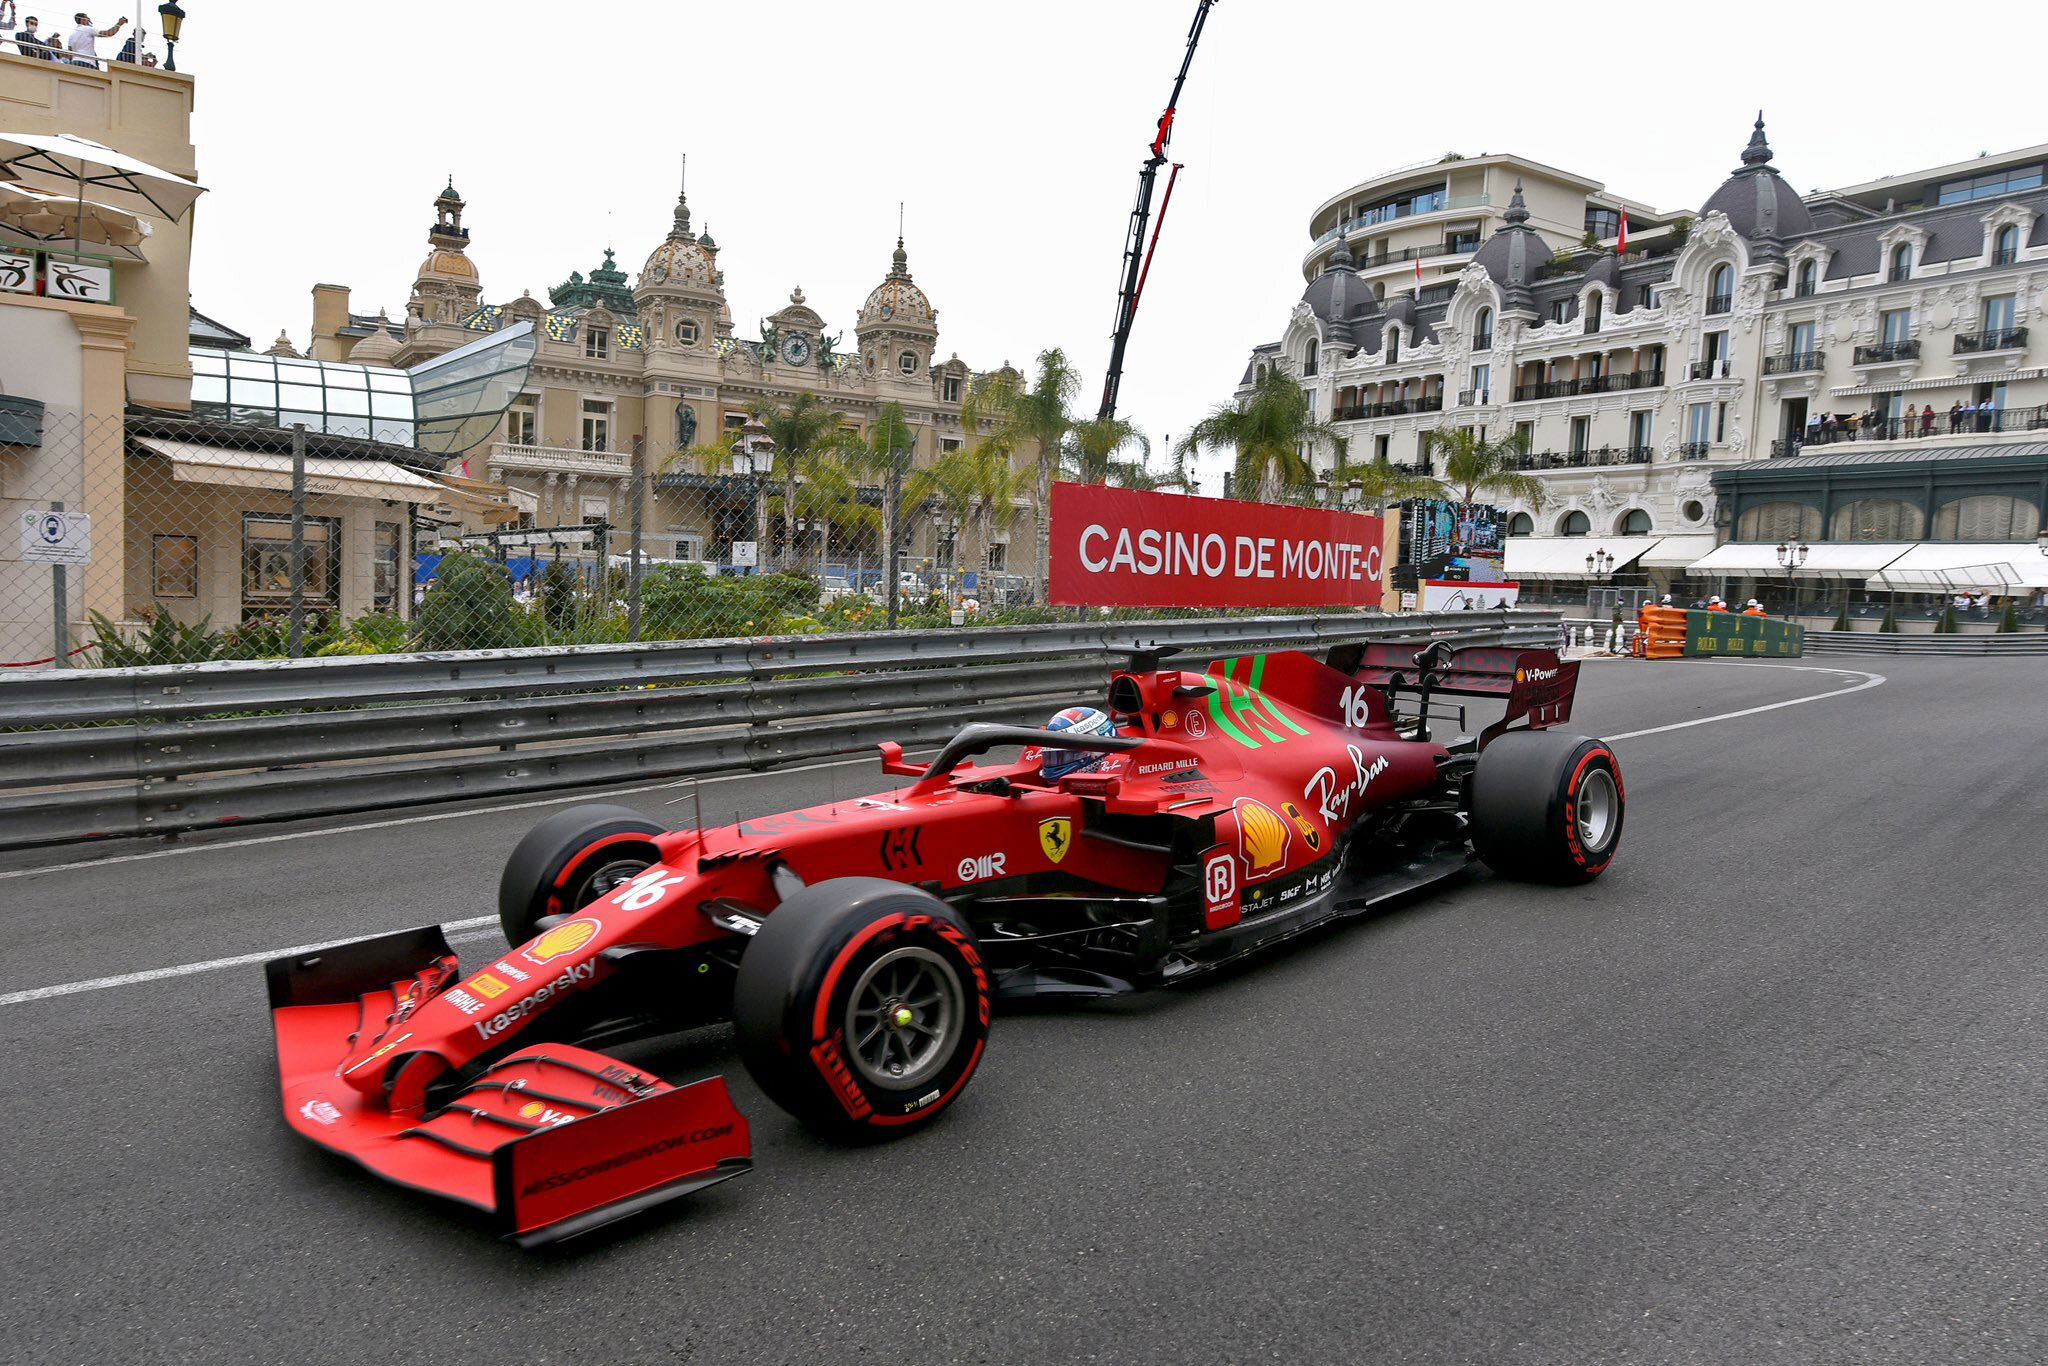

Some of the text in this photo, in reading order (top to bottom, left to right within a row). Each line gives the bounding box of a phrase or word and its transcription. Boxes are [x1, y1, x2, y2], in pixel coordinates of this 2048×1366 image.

[1079, 524, 1383, 582] CASINO DE MONTE-C
[1338, 685, 1369, 728] 16
[1138, 757, 1199, 775] RICHARD MILLE
[1304, 744, 1389, 827] Ray-Ban
[611, 869, 688, 911] 16
[1280, 885, 1302, 901] SKF
[443, 988, 486, 1015] MAHLE
[474, 957, 596, 1041] kaspersky
